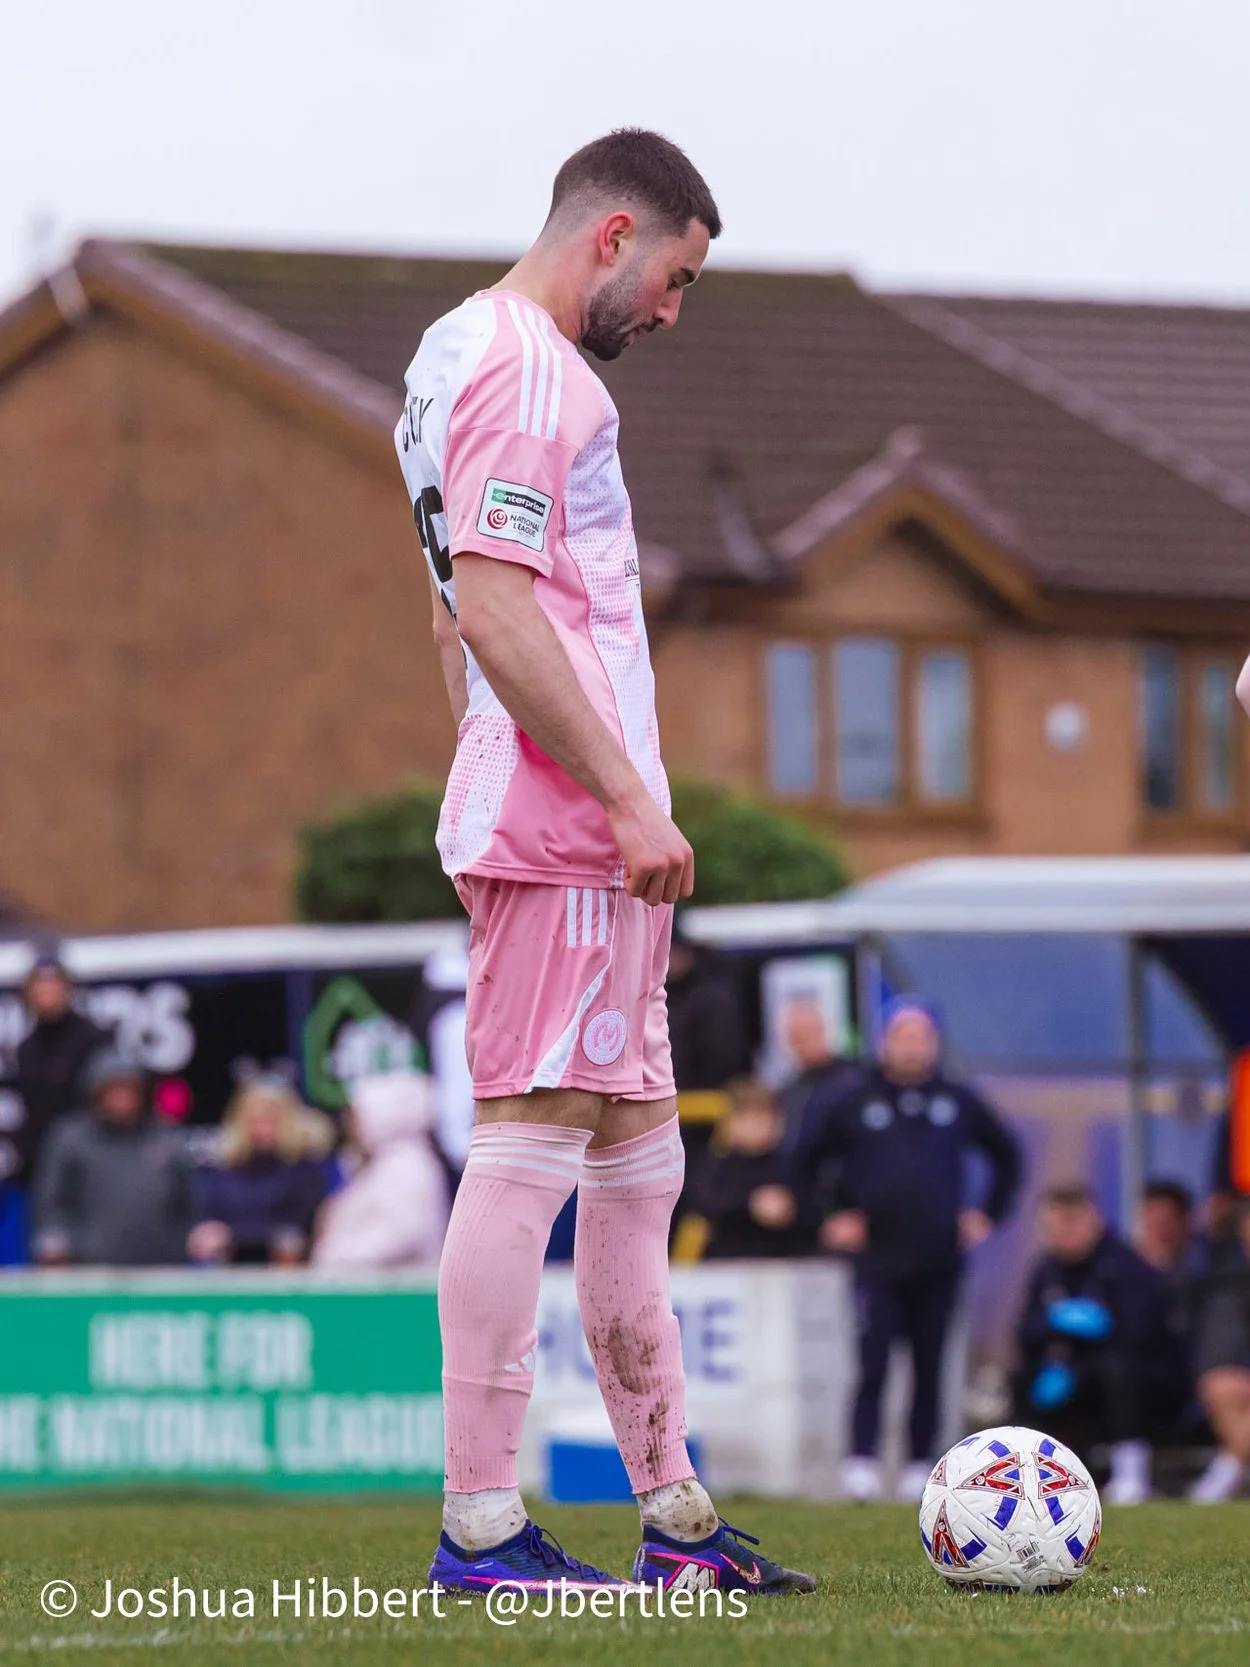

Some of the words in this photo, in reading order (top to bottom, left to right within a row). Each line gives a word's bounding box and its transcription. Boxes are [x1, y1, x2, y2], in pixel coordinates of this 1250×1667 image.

[495, 491, 545, 514] enterprise
[510, 514, 540, 533] NATIONAL
[513, 522, 537, 538] LEAGUE
[50, 1393, 270, 1474] NATIONAL
